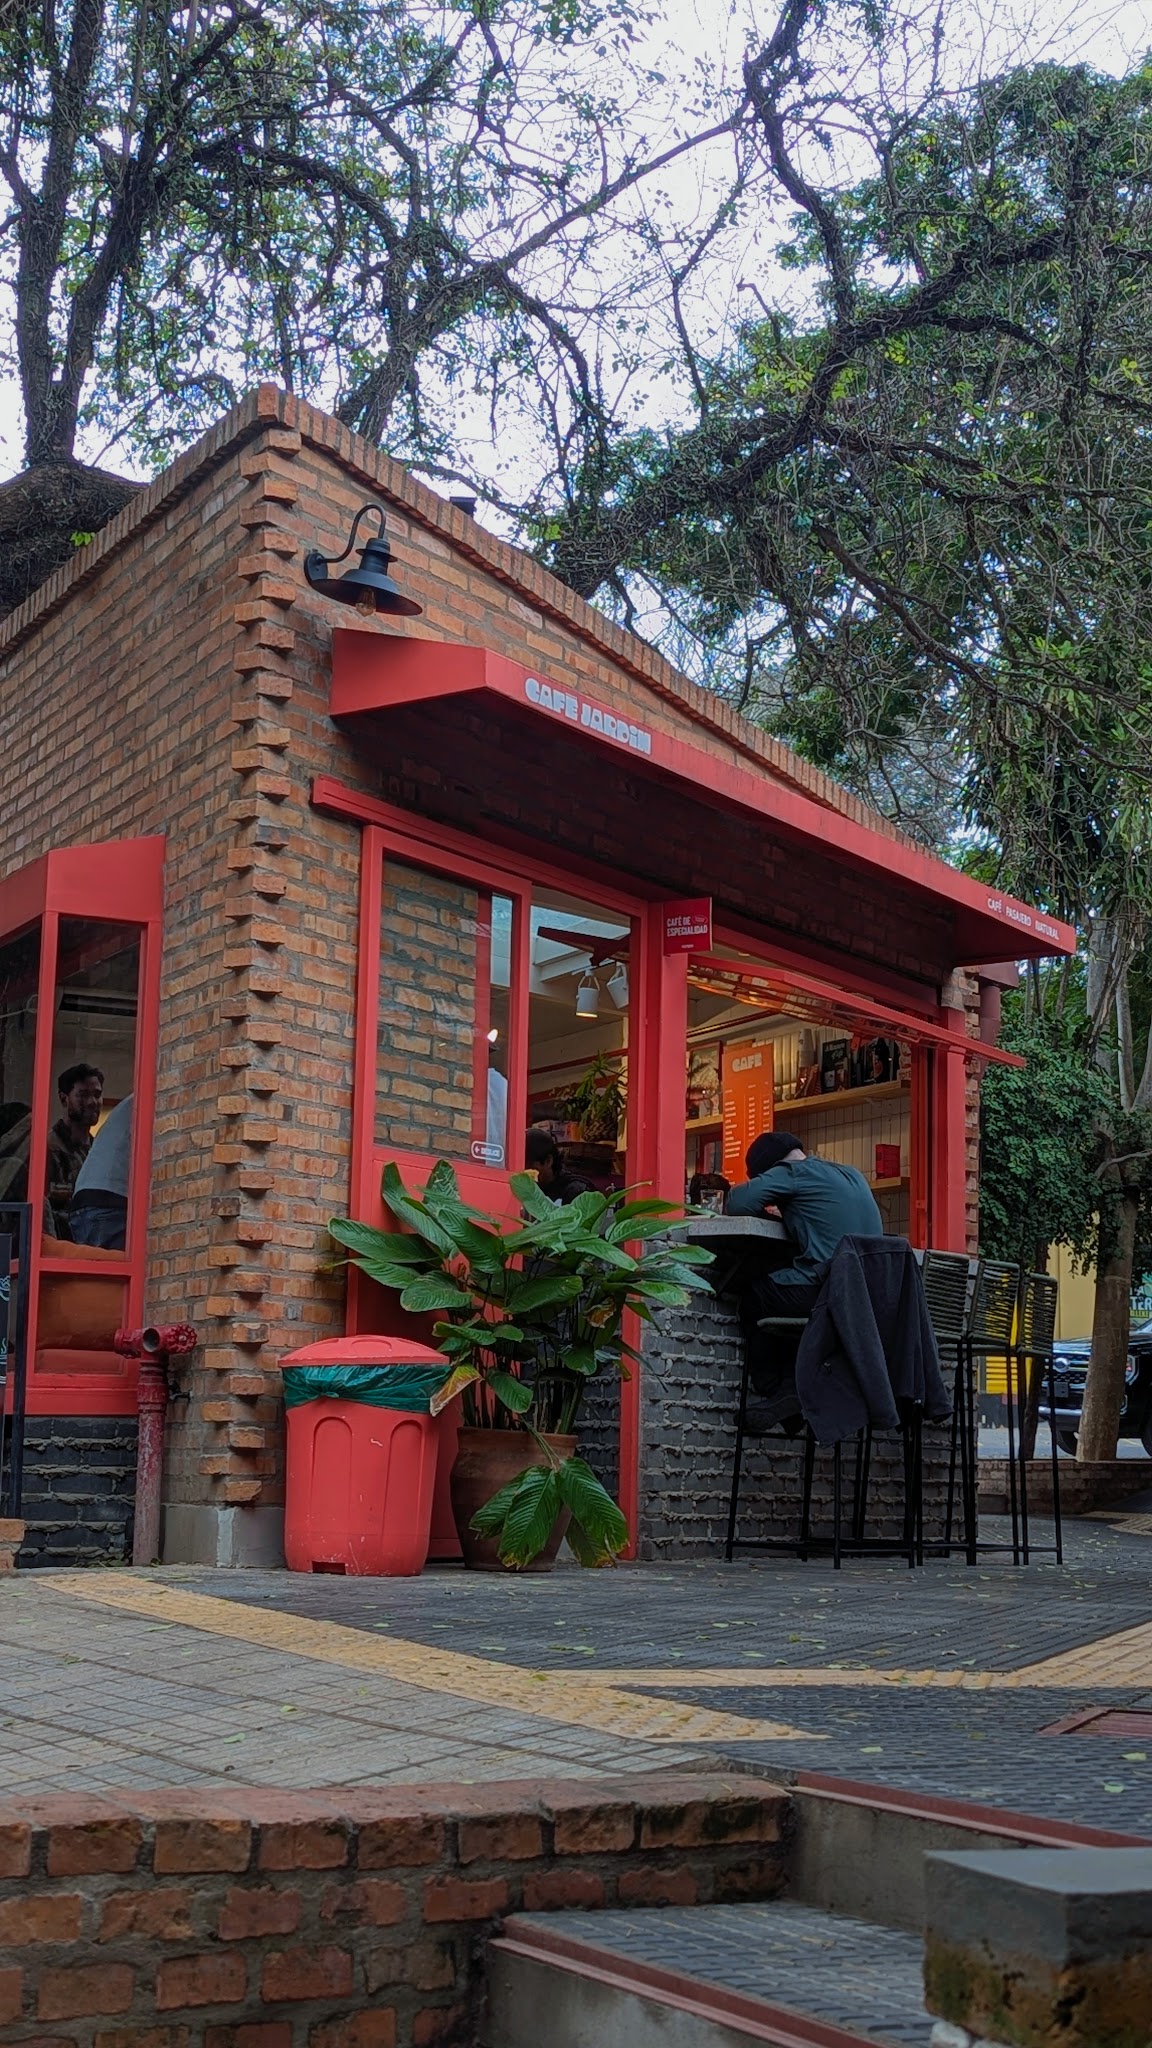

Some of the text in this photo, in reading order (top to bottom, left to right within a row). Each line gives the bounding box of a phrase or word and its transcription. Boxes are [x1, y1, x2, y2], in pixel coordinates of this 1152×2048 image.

[682, 916, 691, 926] DE
[666, 925, 708, 937] ESPECIALIDAD
[1034, 920, 1060, 941] NATURAL
